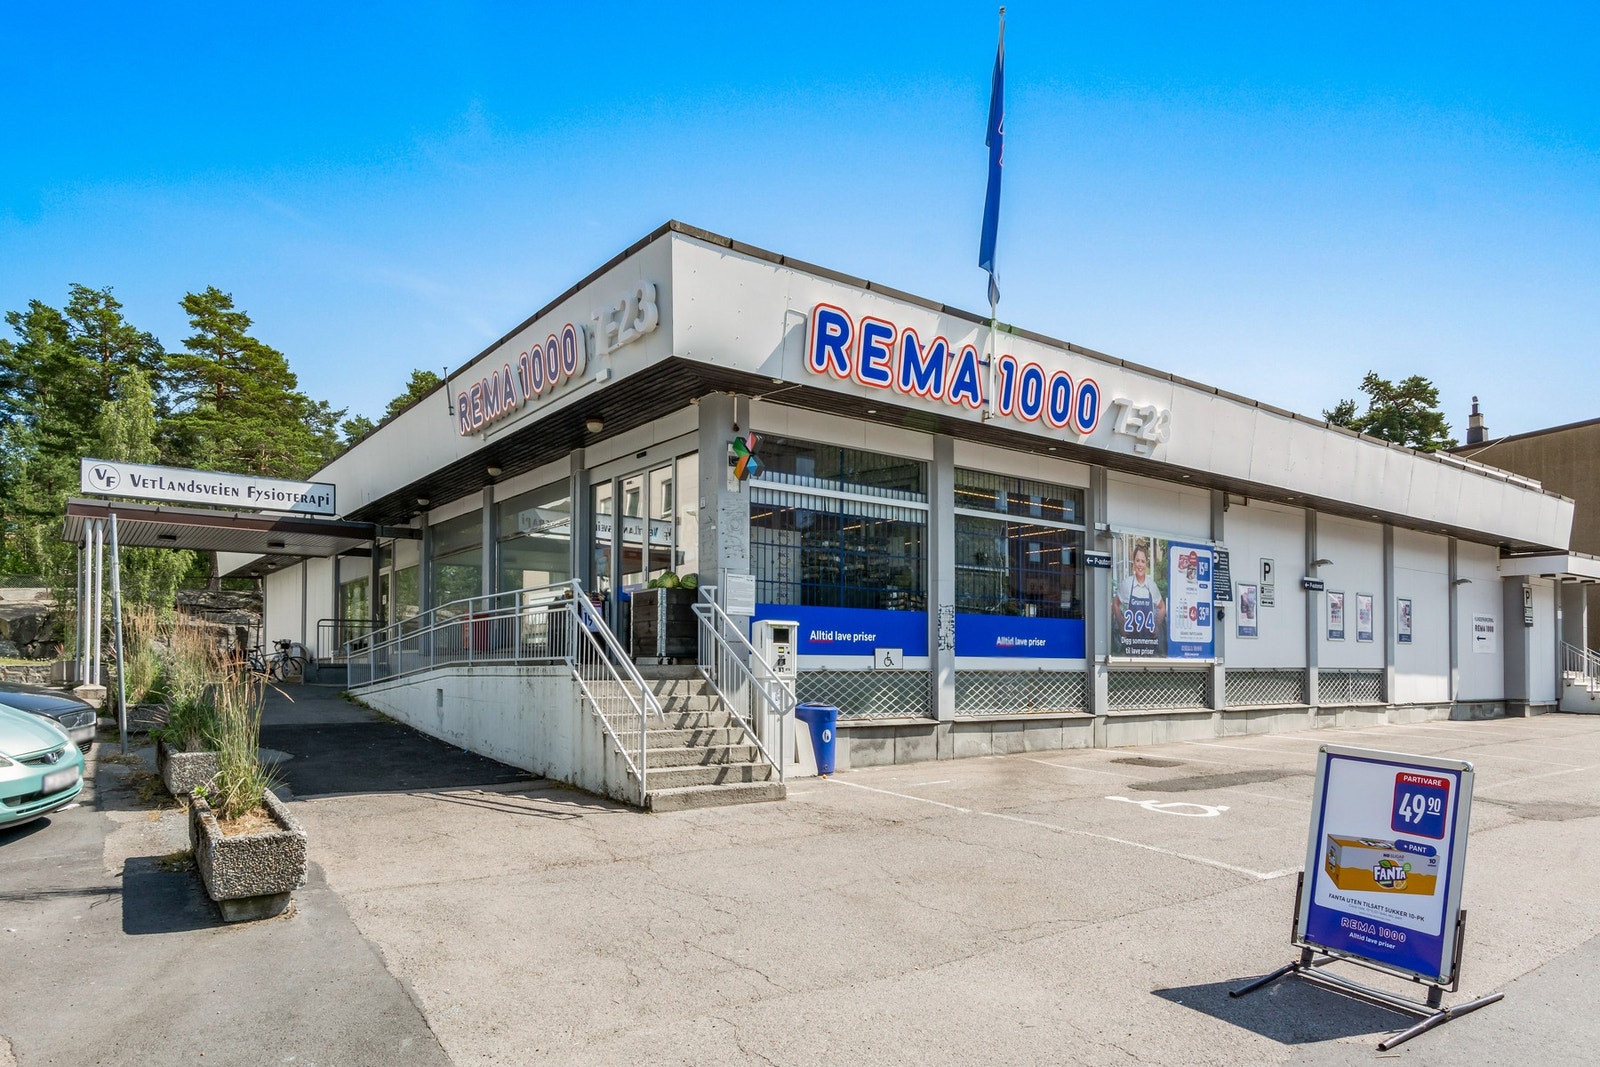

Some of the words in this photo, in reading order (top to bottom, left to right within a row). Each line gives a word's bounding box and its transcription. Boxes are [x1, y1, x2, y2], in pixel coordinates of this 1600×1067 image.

[809, 302, 984, 410] REMA
[999, 354, 1101, 435] 1000
[458, 363, 517, 437] REMA
[518, 323, 578, 400] 1000
[94, 468, 116, 488] VF
[1263, 562, 1271, 581] P
[1124, 609, 1155, 633] 294
[809, 630, 833, 640] Alltid
[835, 631, 852, 641] lave
[853, 631, 876, 643] priser
[996, 636, 1014, 645] Alltid
[1015, 636, 1027, 646] lave
[1028, 637, 1046, 647] priser
[1403, 775, 1442, 787] PARTIVARE
[1409, 844, 1427, 853] PANT
[1373, 865, 1406, 881] FANTA
[1329, 893, 1345, 902] FANTA
[1346, 898, 1361, 906] UTEN
[1363, 901, 1384, 911] TILSATT
[1385, 906, 1408, 917] SUKKER
[1340, 917, 1376, 935] REMA
[1379, 927, 1406, 943] 1000
[1349, 932, 1365, 941] Alltid
[1365, 936, 1378, 945] lave
[1378, 940, 1396, 950] priser
